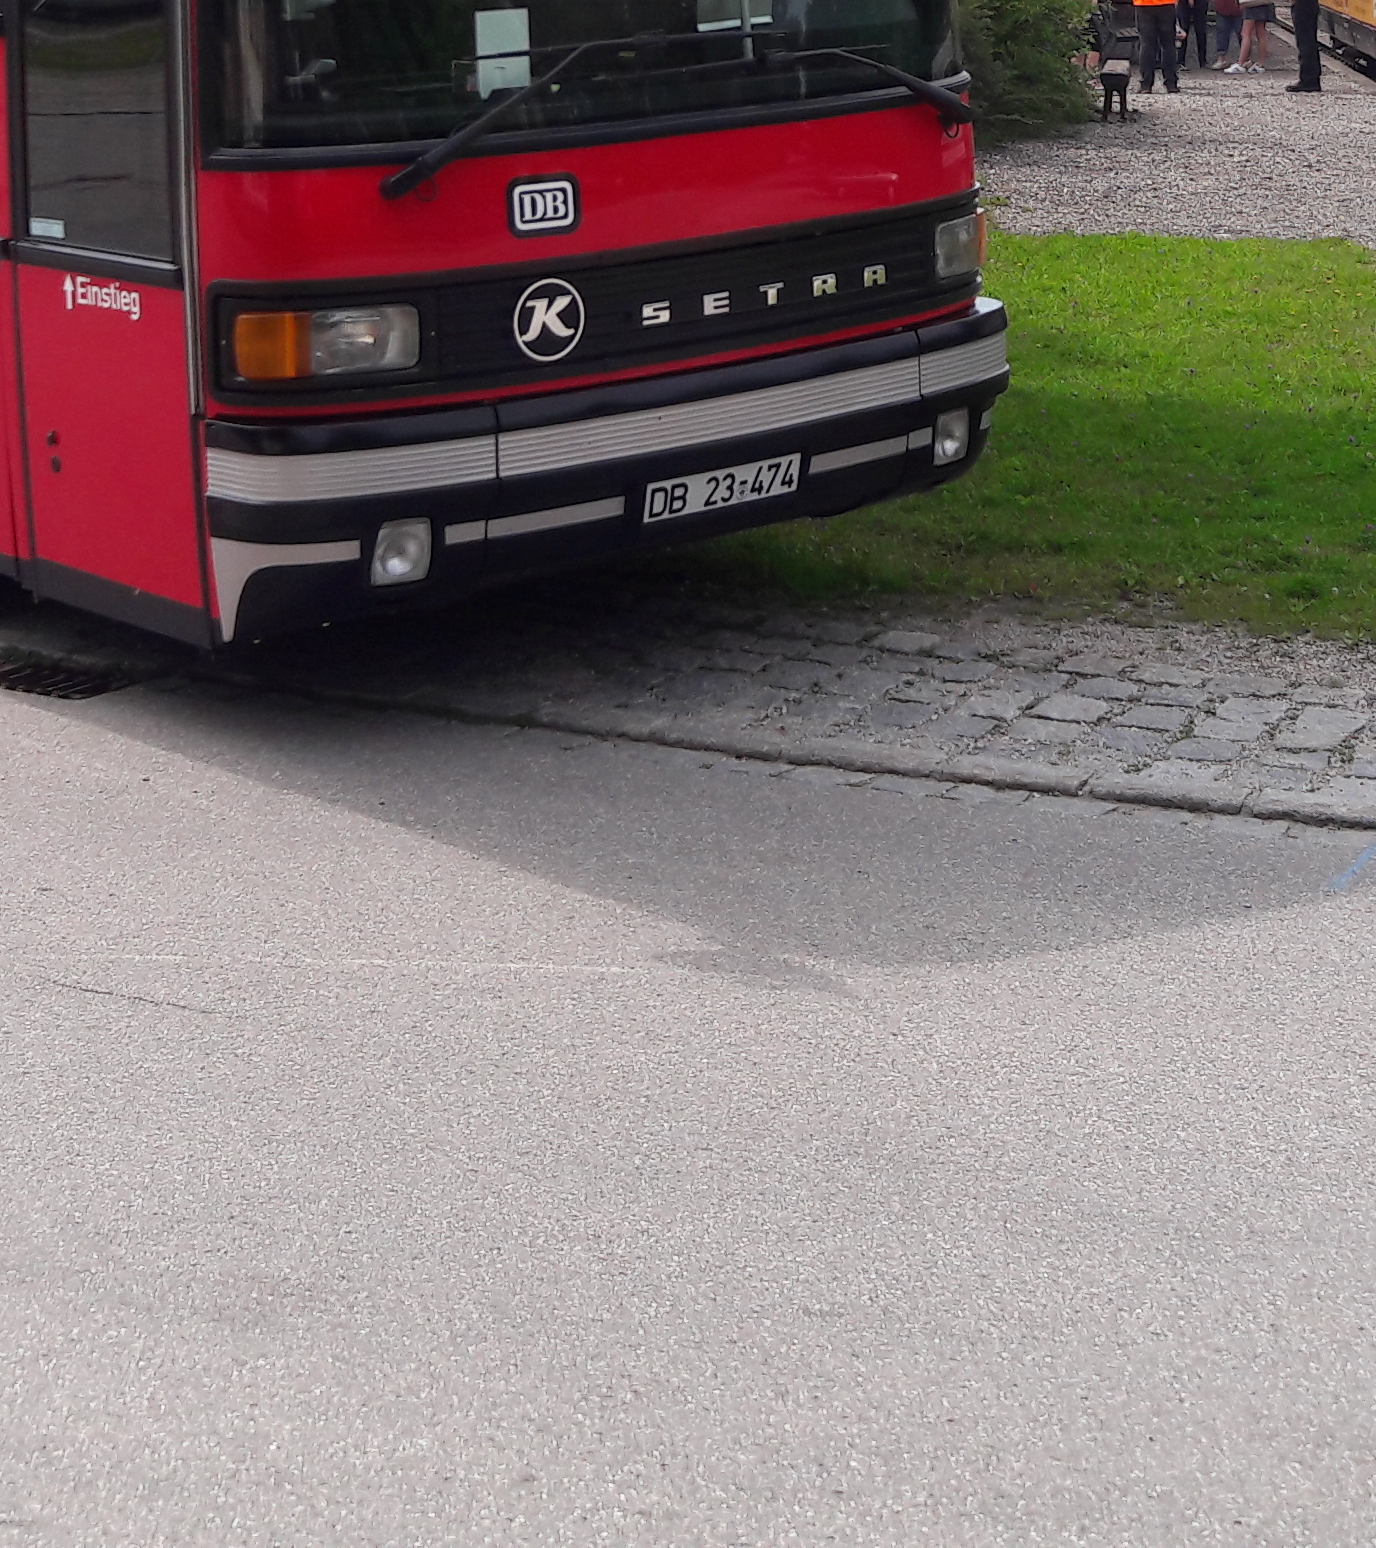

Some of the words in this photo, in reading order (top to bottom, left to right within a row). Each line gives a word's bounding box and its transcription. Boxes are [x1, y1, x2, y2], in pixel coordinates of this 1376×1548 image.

[522, 190, 566, 222] DB
[76, 275, 141, 321] Einstieg
[641, 263, 887, 327] SETRA
[648, 482, 689, 519] DB
